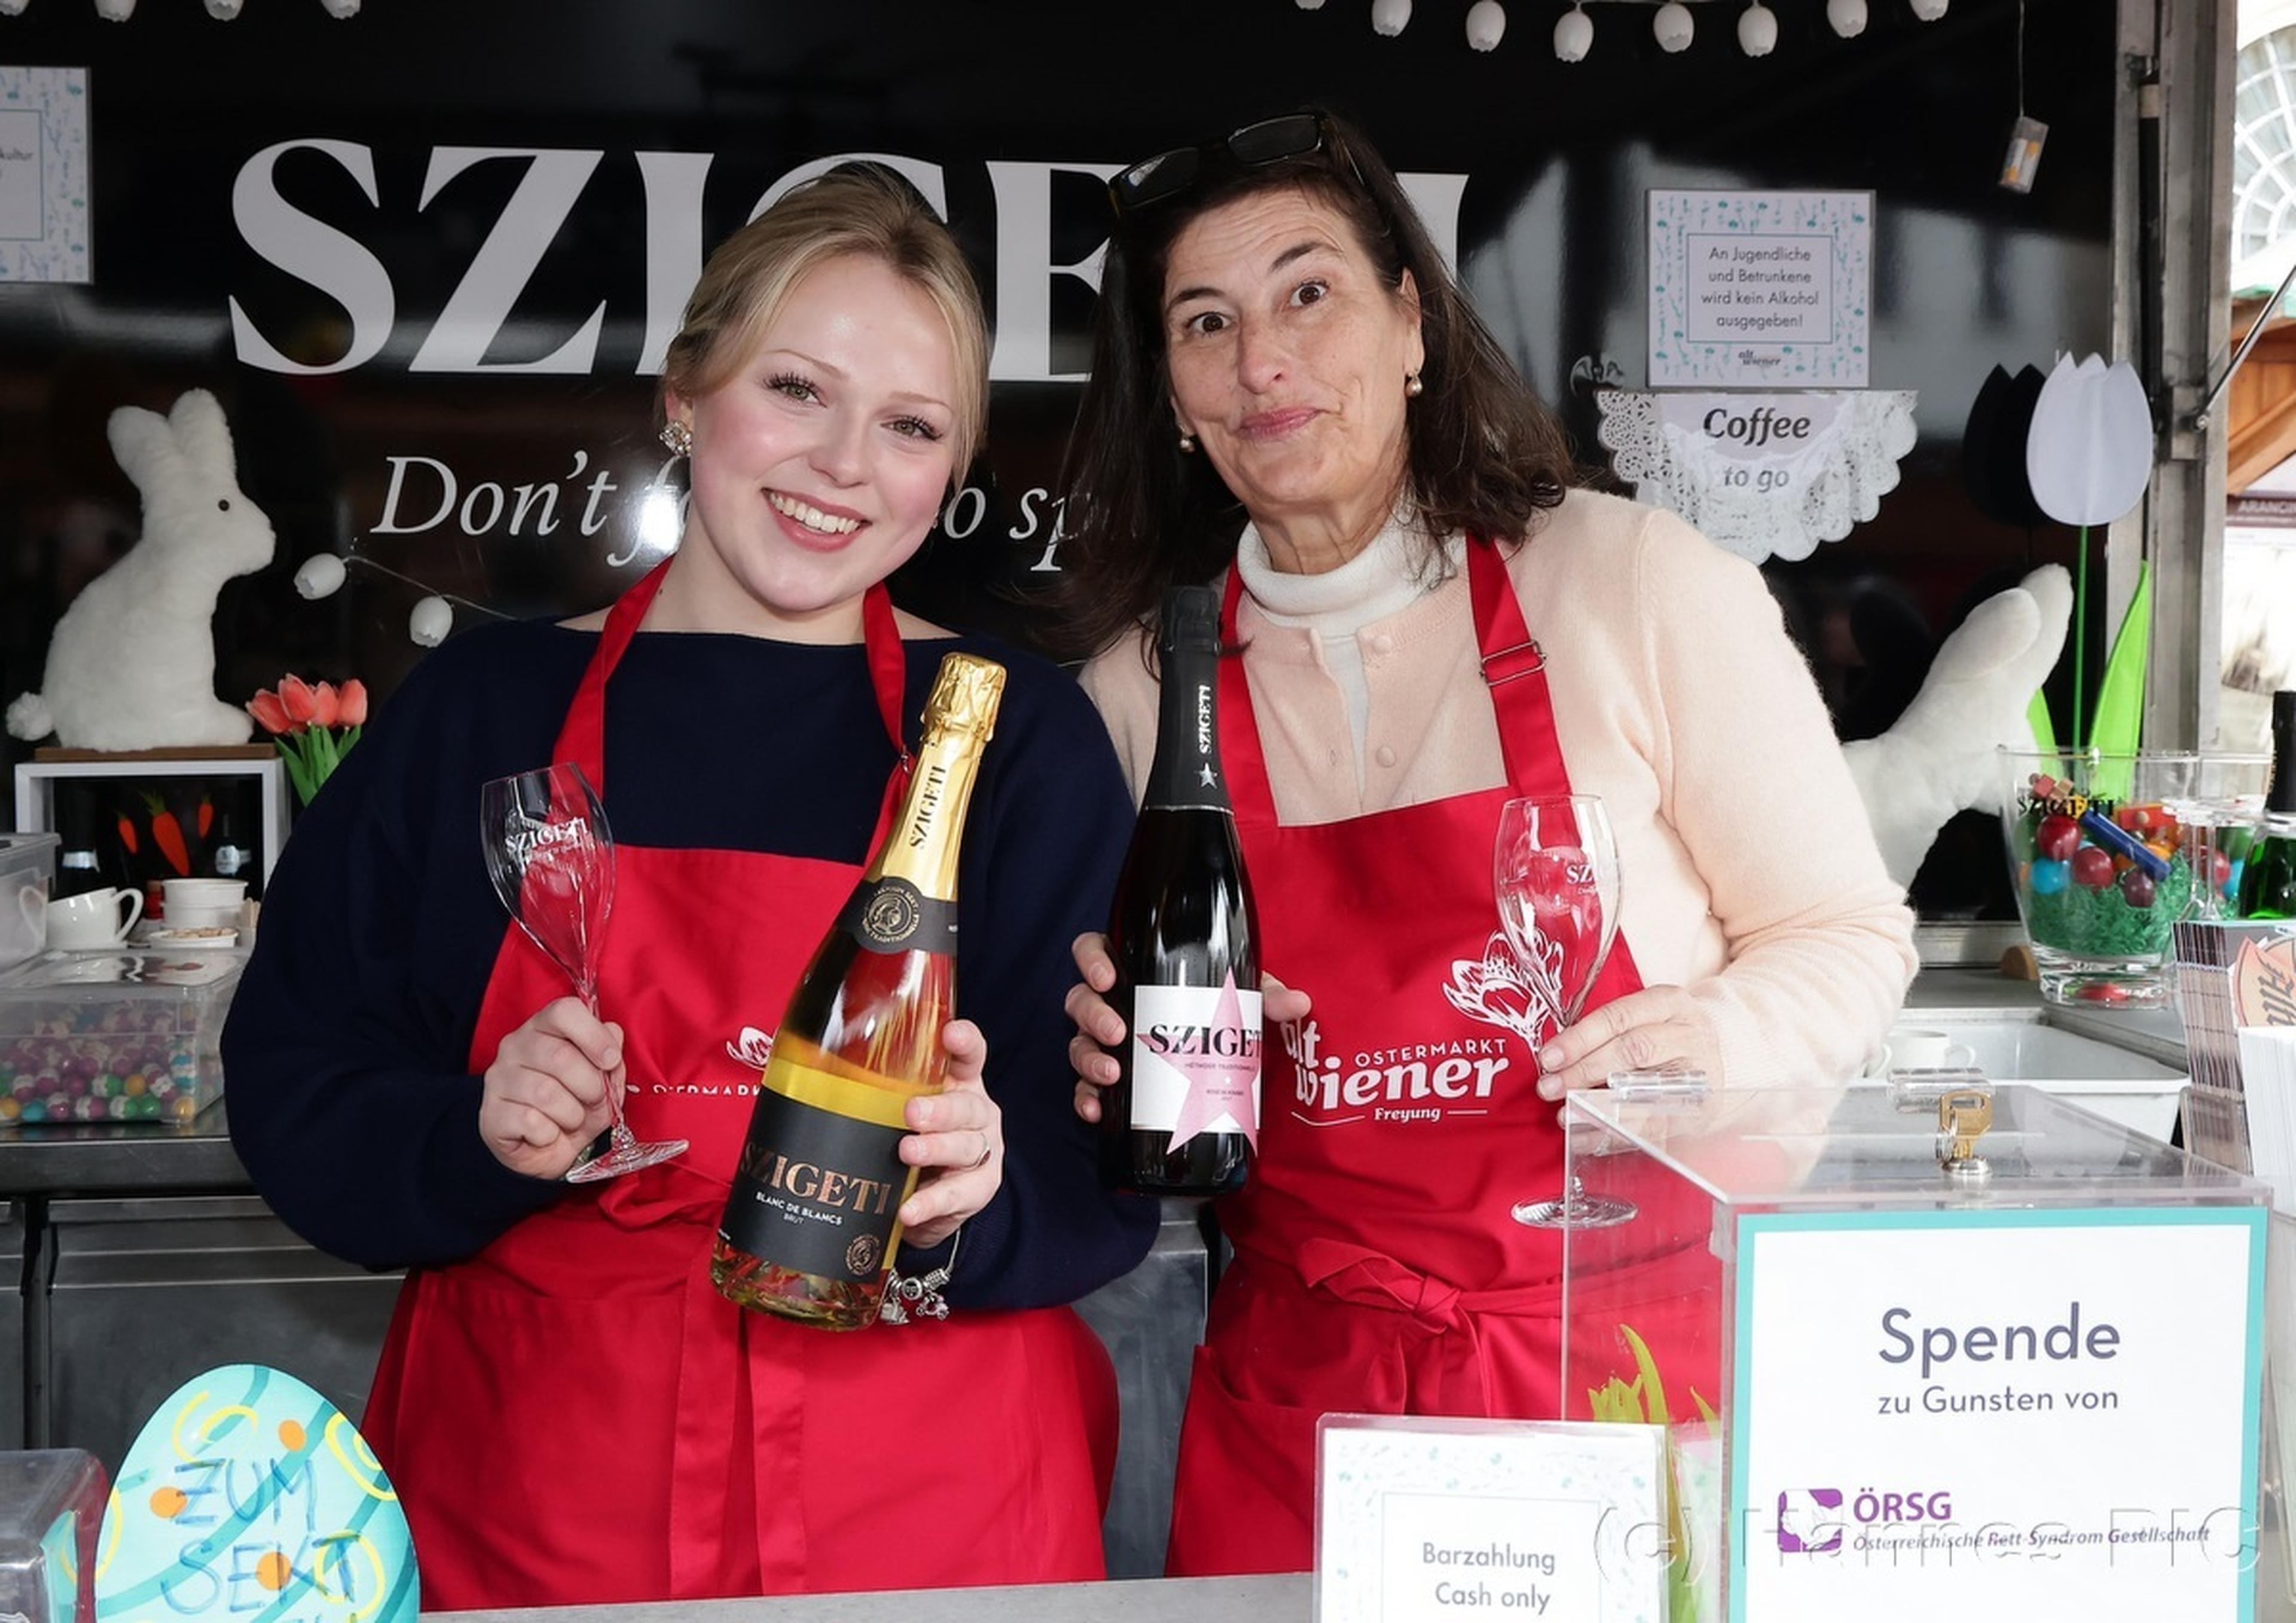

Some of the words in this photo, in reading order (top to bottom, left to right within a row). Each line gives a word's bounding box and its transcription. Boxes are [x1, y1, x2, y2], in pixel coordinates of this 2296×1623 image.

[229, 138, 1469, 383] SZIE
[1709, 247, 1729, 260] An
[1732, 246, 1812, 264] Jugendliche
[1708, 269, 1734, 282] und
[1739, 269, 1812, 283] Betrunkene
[1701, 291, 1732, 305] wird
[1736, 290, 1764, 305] kein
[1768, 291, 1819, 306] Alkohol
[1717, 313, 1803, 331] ausgegeben!
[1703, 407, 1810, 446] Coffee
[1723, 466, 1749, 487] to
[1757, 470, 1790, 493] go
[1198, 685, 1212, 755] SZIGETI
[910, 765, 947, 849] SZIGETI
[1355, 1039, 1507, 1067] OSTERMARKT
[1295, 1056, 1510, 1111] wiener
[1375, 1107, 1441, 1123] Freyung
[740, 1142, 892, 1215] SZIGETI
[756, 1191, 785, 1209] BLANC
[786, 1202, 799, 1213] DE
[801, 1207, 842, 1226] BLANCS
[783, 1212, 805, 1225] BRUT
[1879, 1302, 2121, 1378] Spende
[1879, 1396, 1910, 1414] zu
[1922, 1386, 2053, 1412] Gunsten
[2065, 1391, 2119, 1410] von
[175, 1458, 318, 1533] ZUM
[1854, 1487, 1952, 1523] ÖRSG
[1854, 1532, 1984, 1551] Österreichische
[1987, 1527, 2103, 1550] Rett-Syndrom
[2108, 1526, 2210, 1544] Gesellschaft
[160, 1531, 362, 1615] SEKT
[1423, 1542, 1556, 1576] Barzahlung
[1436, 1582, 1492, 1607] Cash
[1501, 1585, 1552, 1616] only
